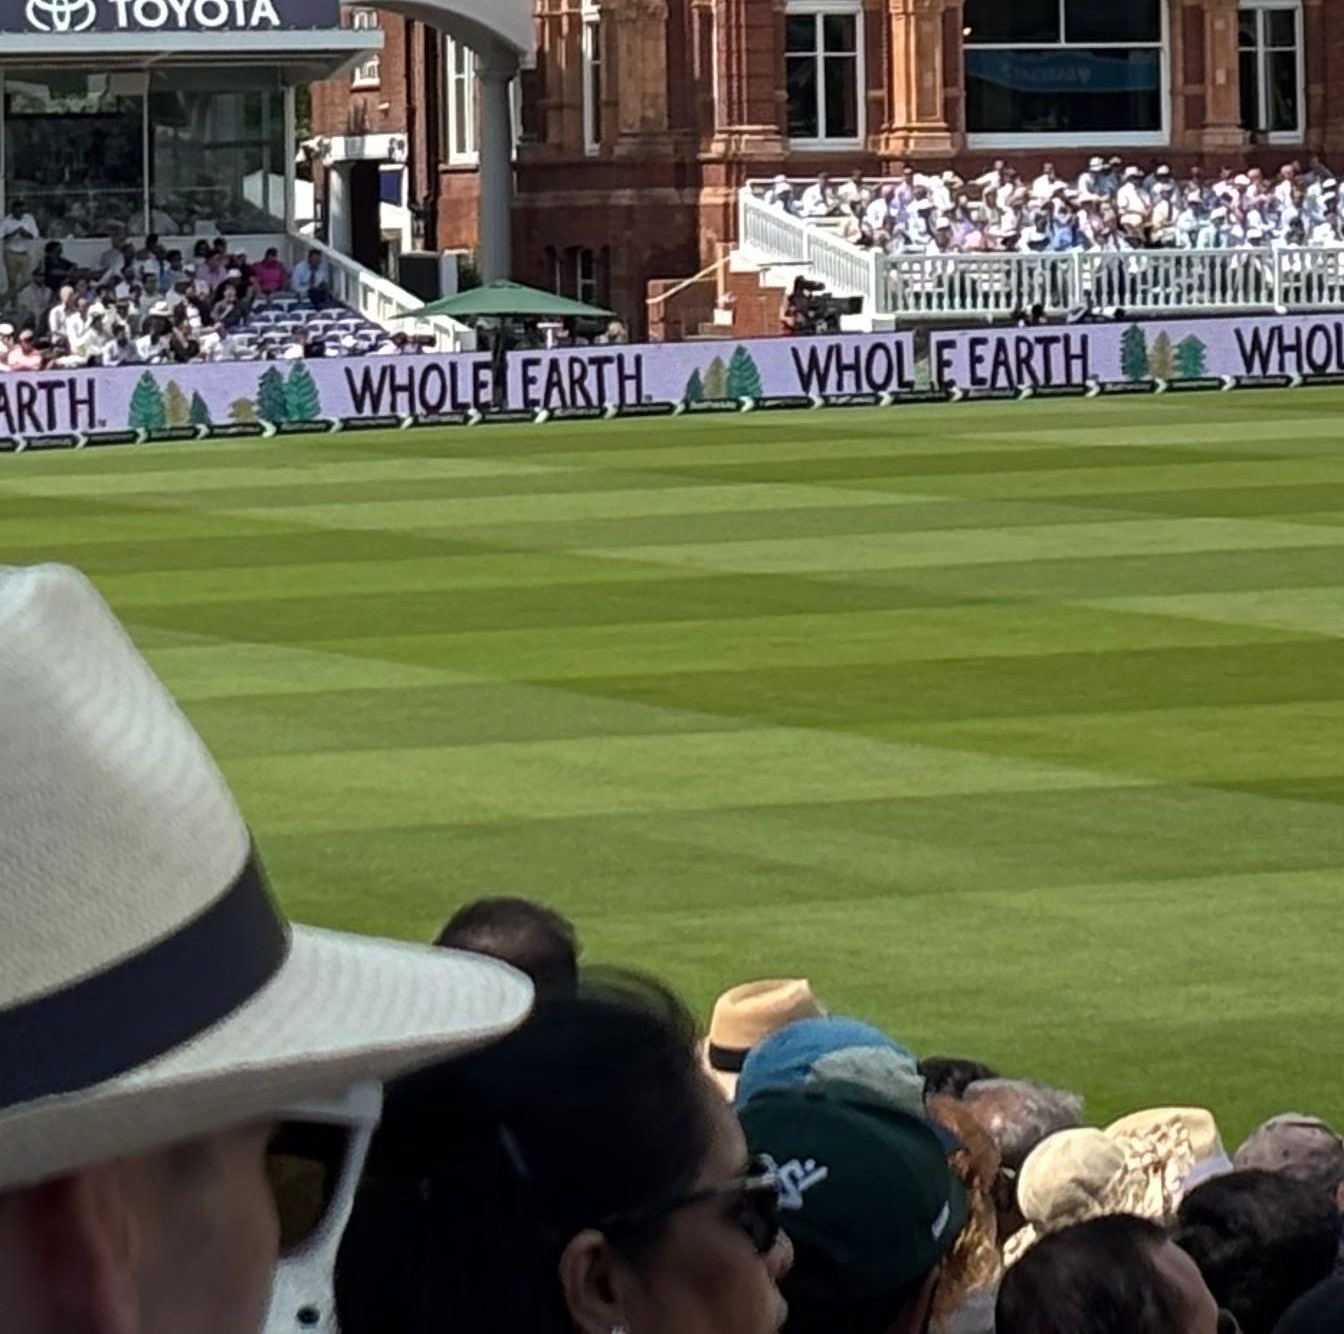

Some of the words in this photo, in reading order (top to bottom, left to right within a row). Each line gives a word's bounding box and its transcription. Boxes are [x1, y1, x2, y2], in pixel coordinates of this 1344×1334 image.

[344, 360, 493, 414] WHOLE
[522, 353, 643, 408] EARTH
[968, 334, 1089, 389] EARTH
